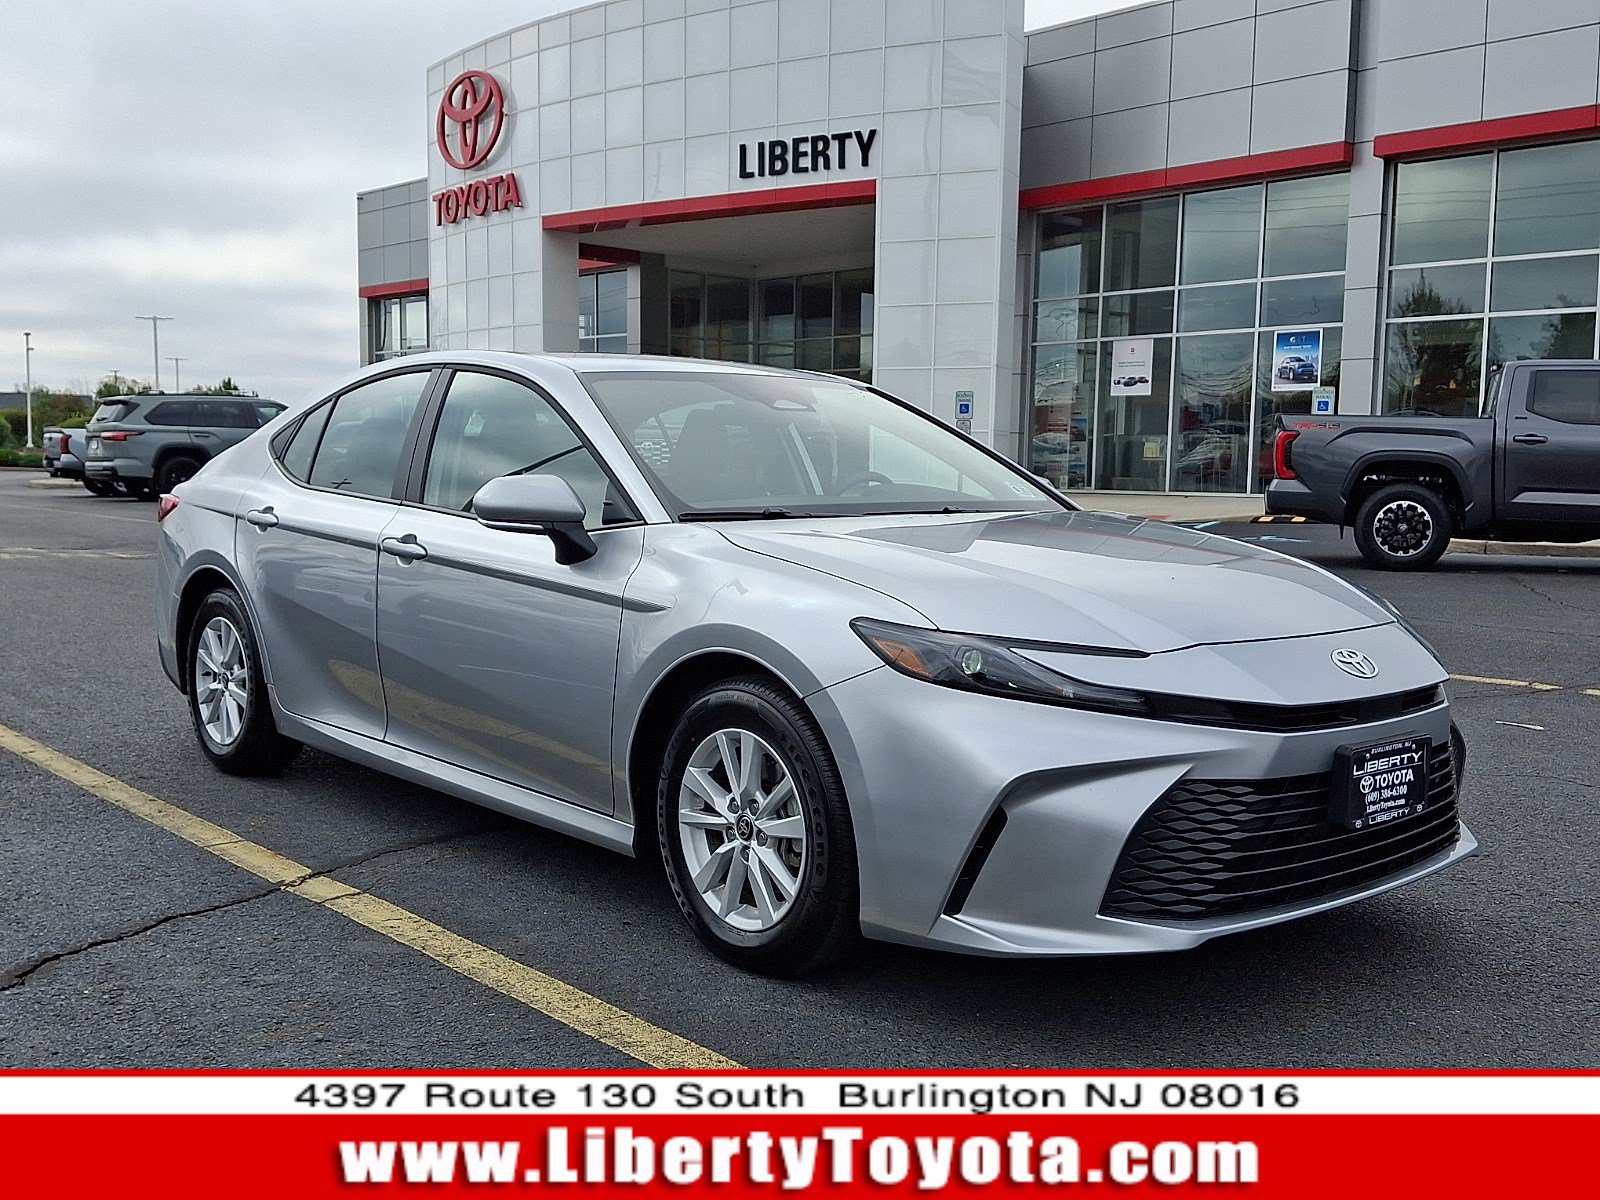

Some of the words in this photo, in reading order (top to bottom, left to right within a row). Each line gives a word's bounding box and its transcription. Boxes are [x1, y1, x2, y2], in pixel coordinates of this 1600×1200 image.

[738, 128, 877, 179] LIBERTY
[431, 173, 522, 225] TOYOTA
[1353, 751, 1422, 775] LIBERTY
[1375, 768, 1414, 788] TOYOTA
[1369, 807, 1410, 824] LIBERTY
